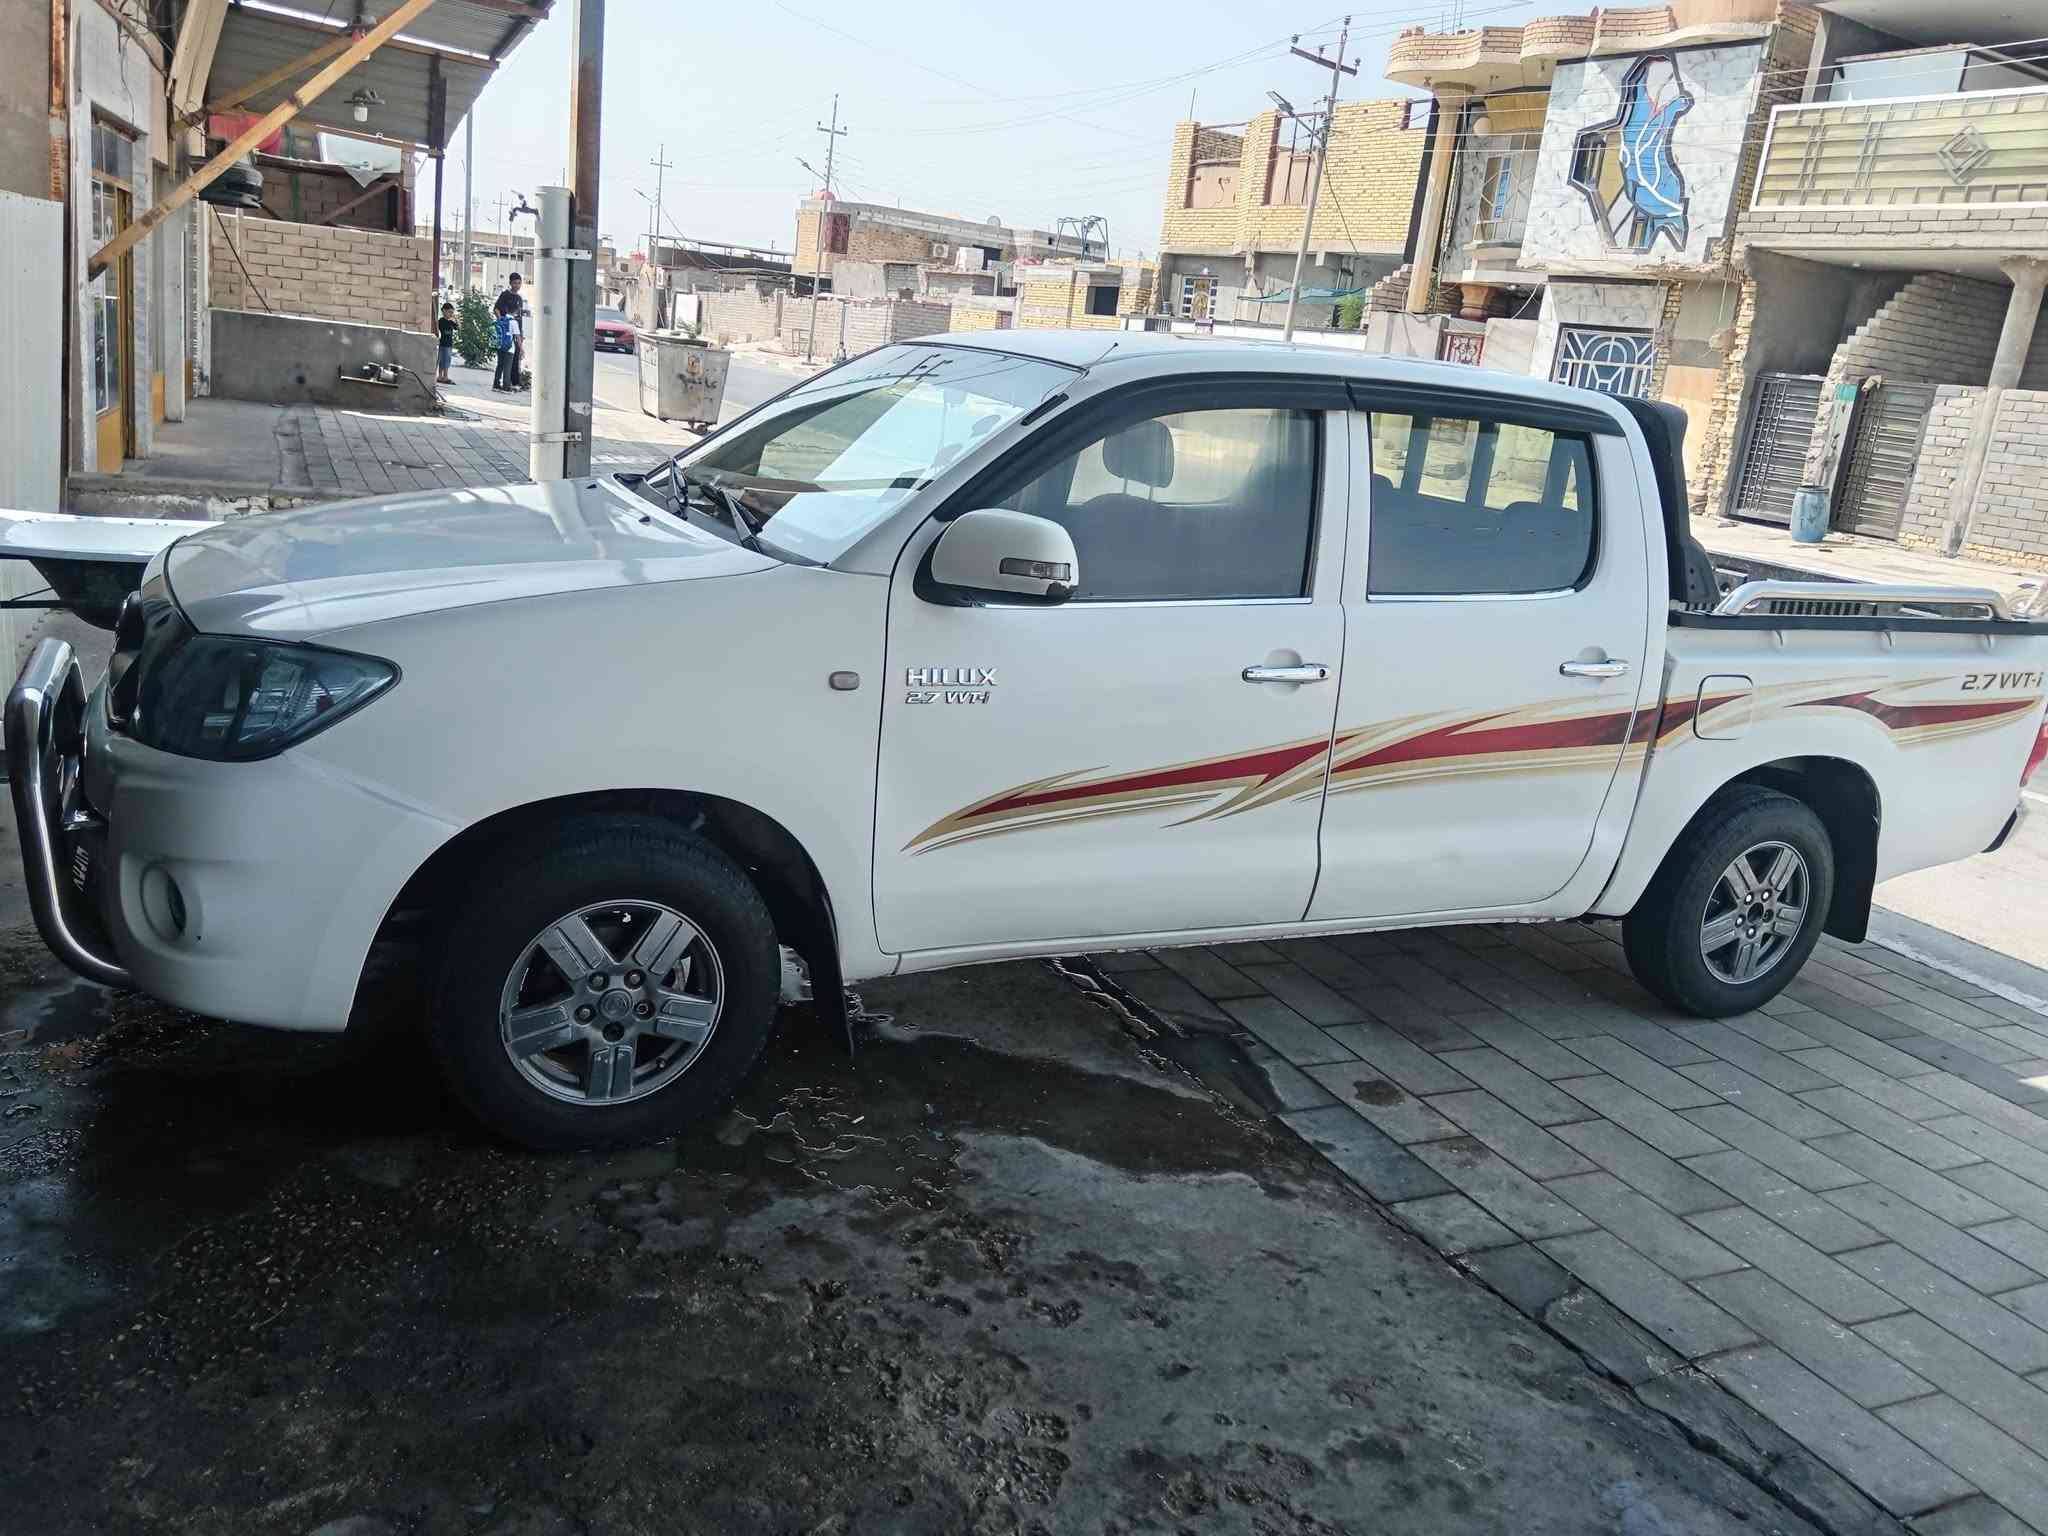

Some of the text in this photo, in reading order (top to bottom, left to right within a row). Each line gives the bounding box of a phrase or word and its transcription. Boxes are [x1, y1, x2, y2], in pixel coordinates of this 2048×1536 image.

[905, 667, 998, 687] HILUX
[1960, 671, 2045, 690] 2.7 VVT-i
